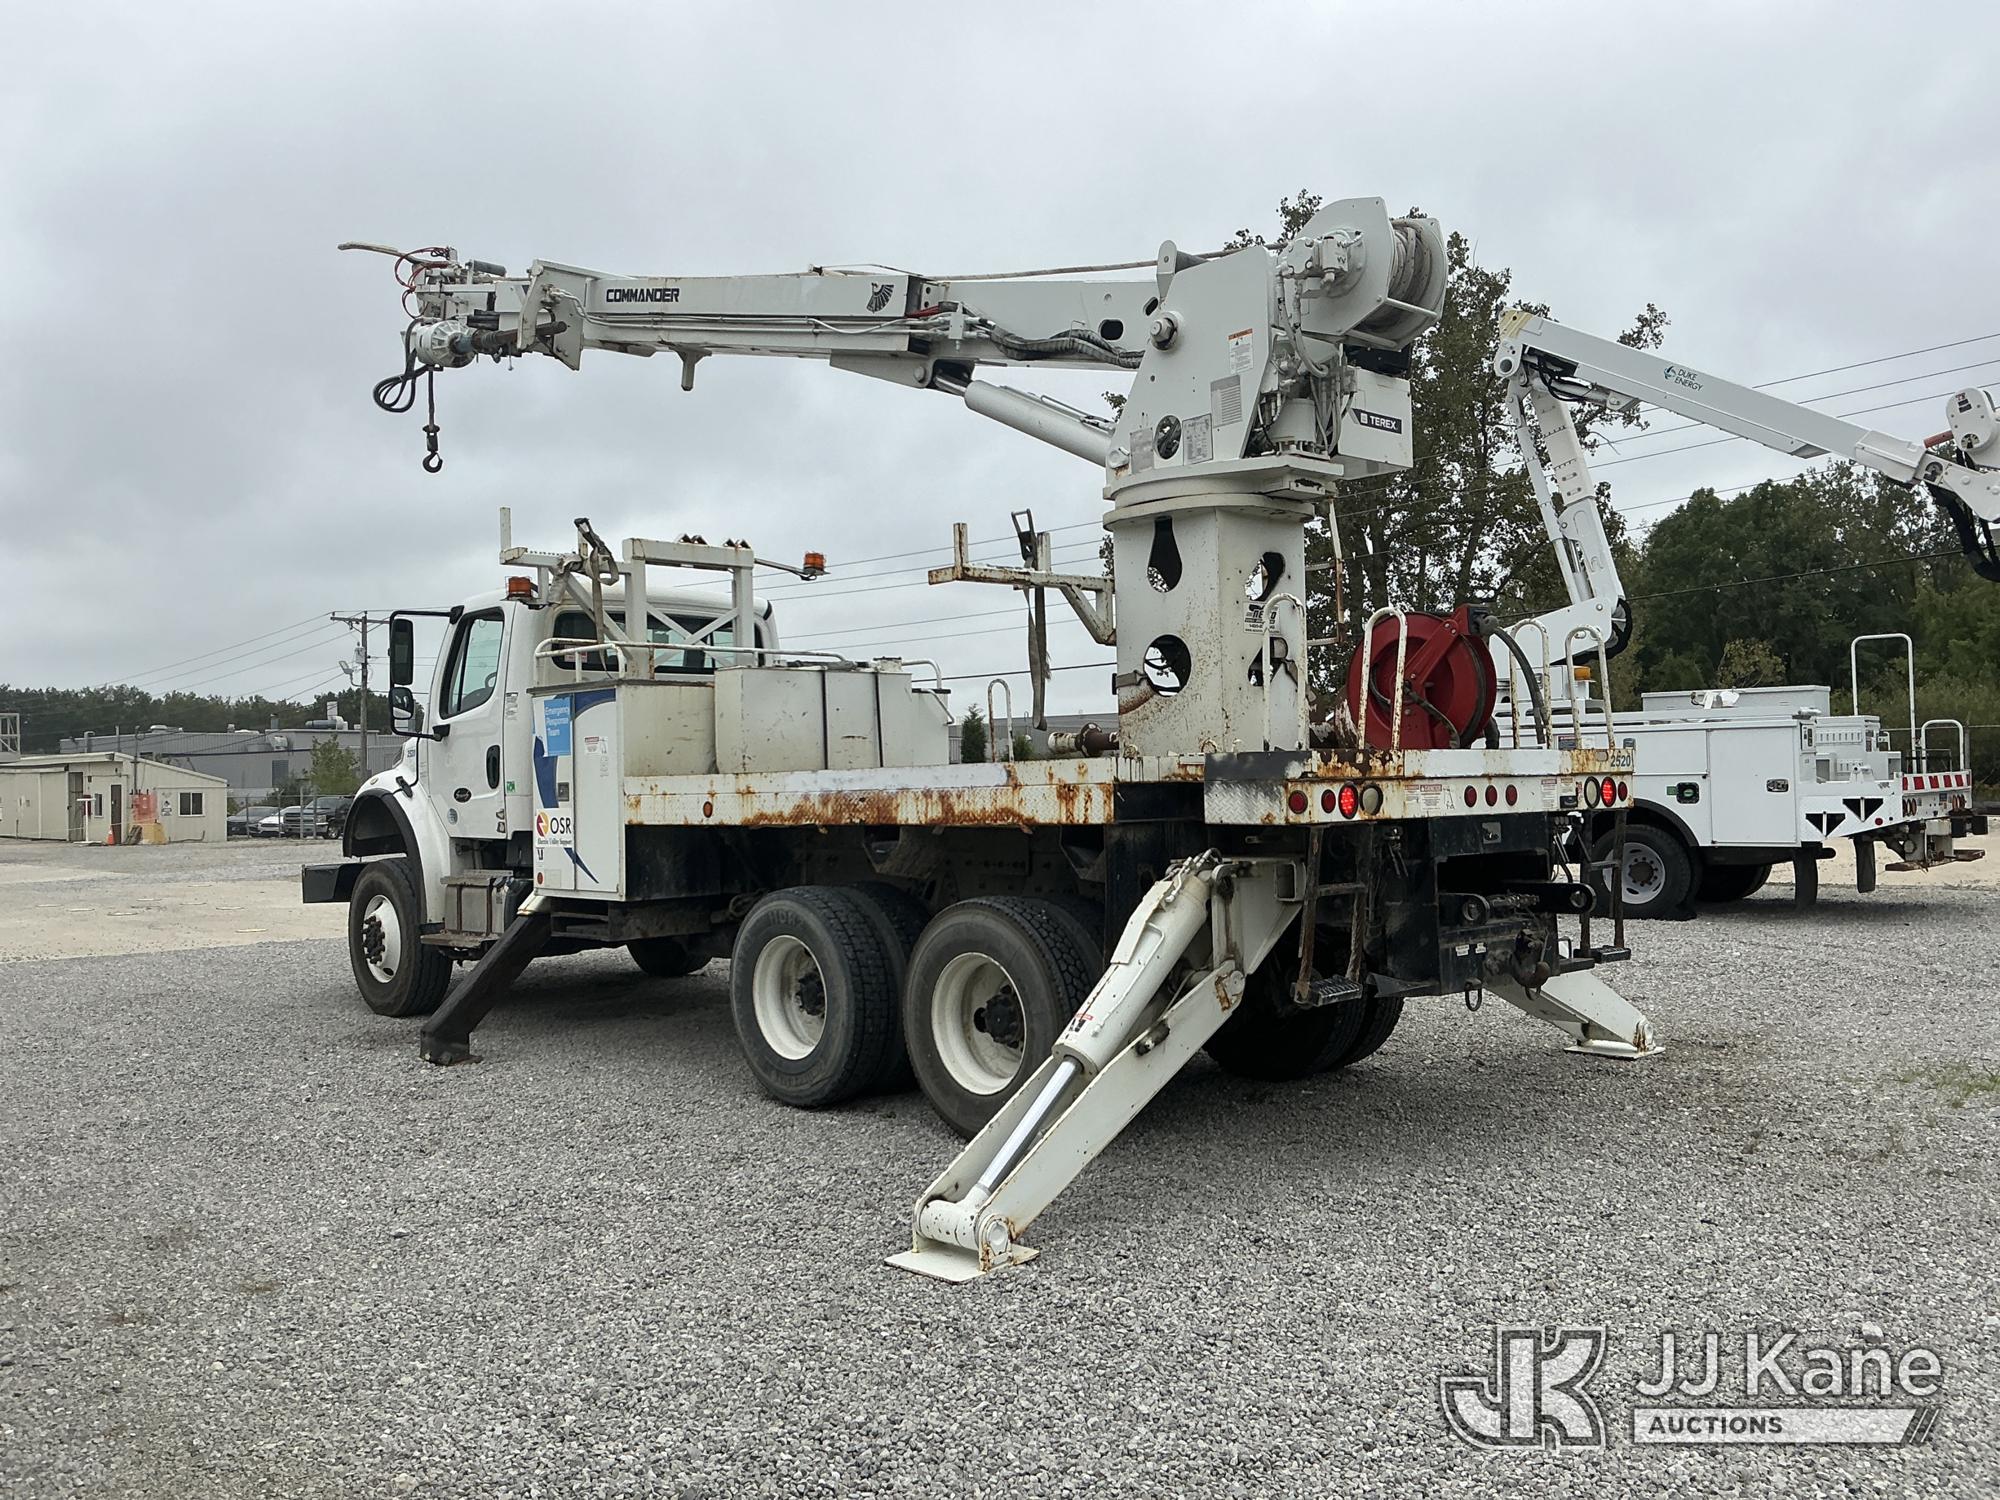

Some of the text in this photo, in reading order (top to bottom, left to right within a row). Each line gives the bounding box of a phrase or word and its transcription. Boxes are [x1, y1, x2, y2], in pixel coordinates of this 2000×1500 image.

[606, 288, 680, 303] COMMANDER
[1678, 368, 1698, 381] DUKE
[1674, 376, 1704, 391] ENERGY
[1370, 415, 1397, 430] TEREX
[1610, 754, 1631, 768] 2520
[550, 816, 572, 835] OSR
